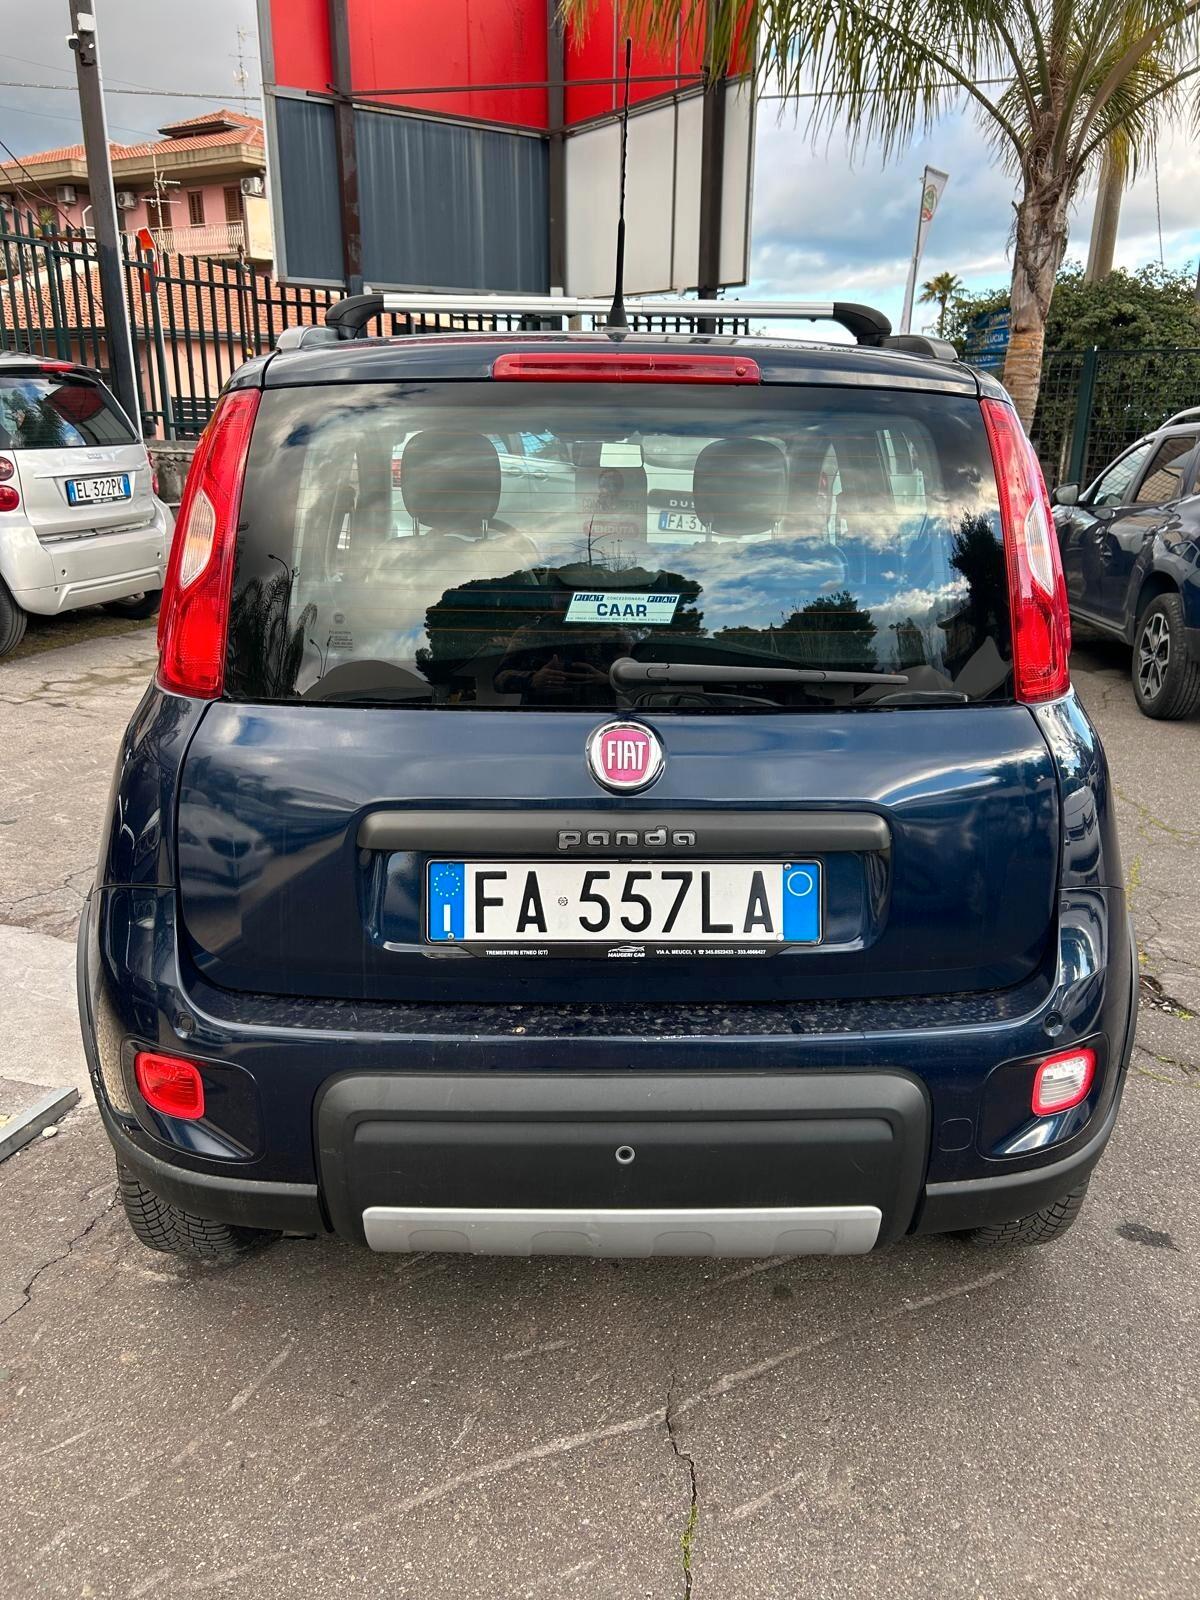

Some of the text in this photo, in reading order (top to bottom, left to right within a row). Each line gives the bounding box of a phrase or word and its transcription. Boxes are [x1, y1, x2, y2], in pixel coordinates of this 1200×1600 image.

[76, 478, 124, 499] EL 322PK
[596, 603, 648, 617] CAAR
[607, 740, 647, 770] FIAT
[558, 825, 697, 850] panda
[475, 870, 775, 933] FA 557LA
